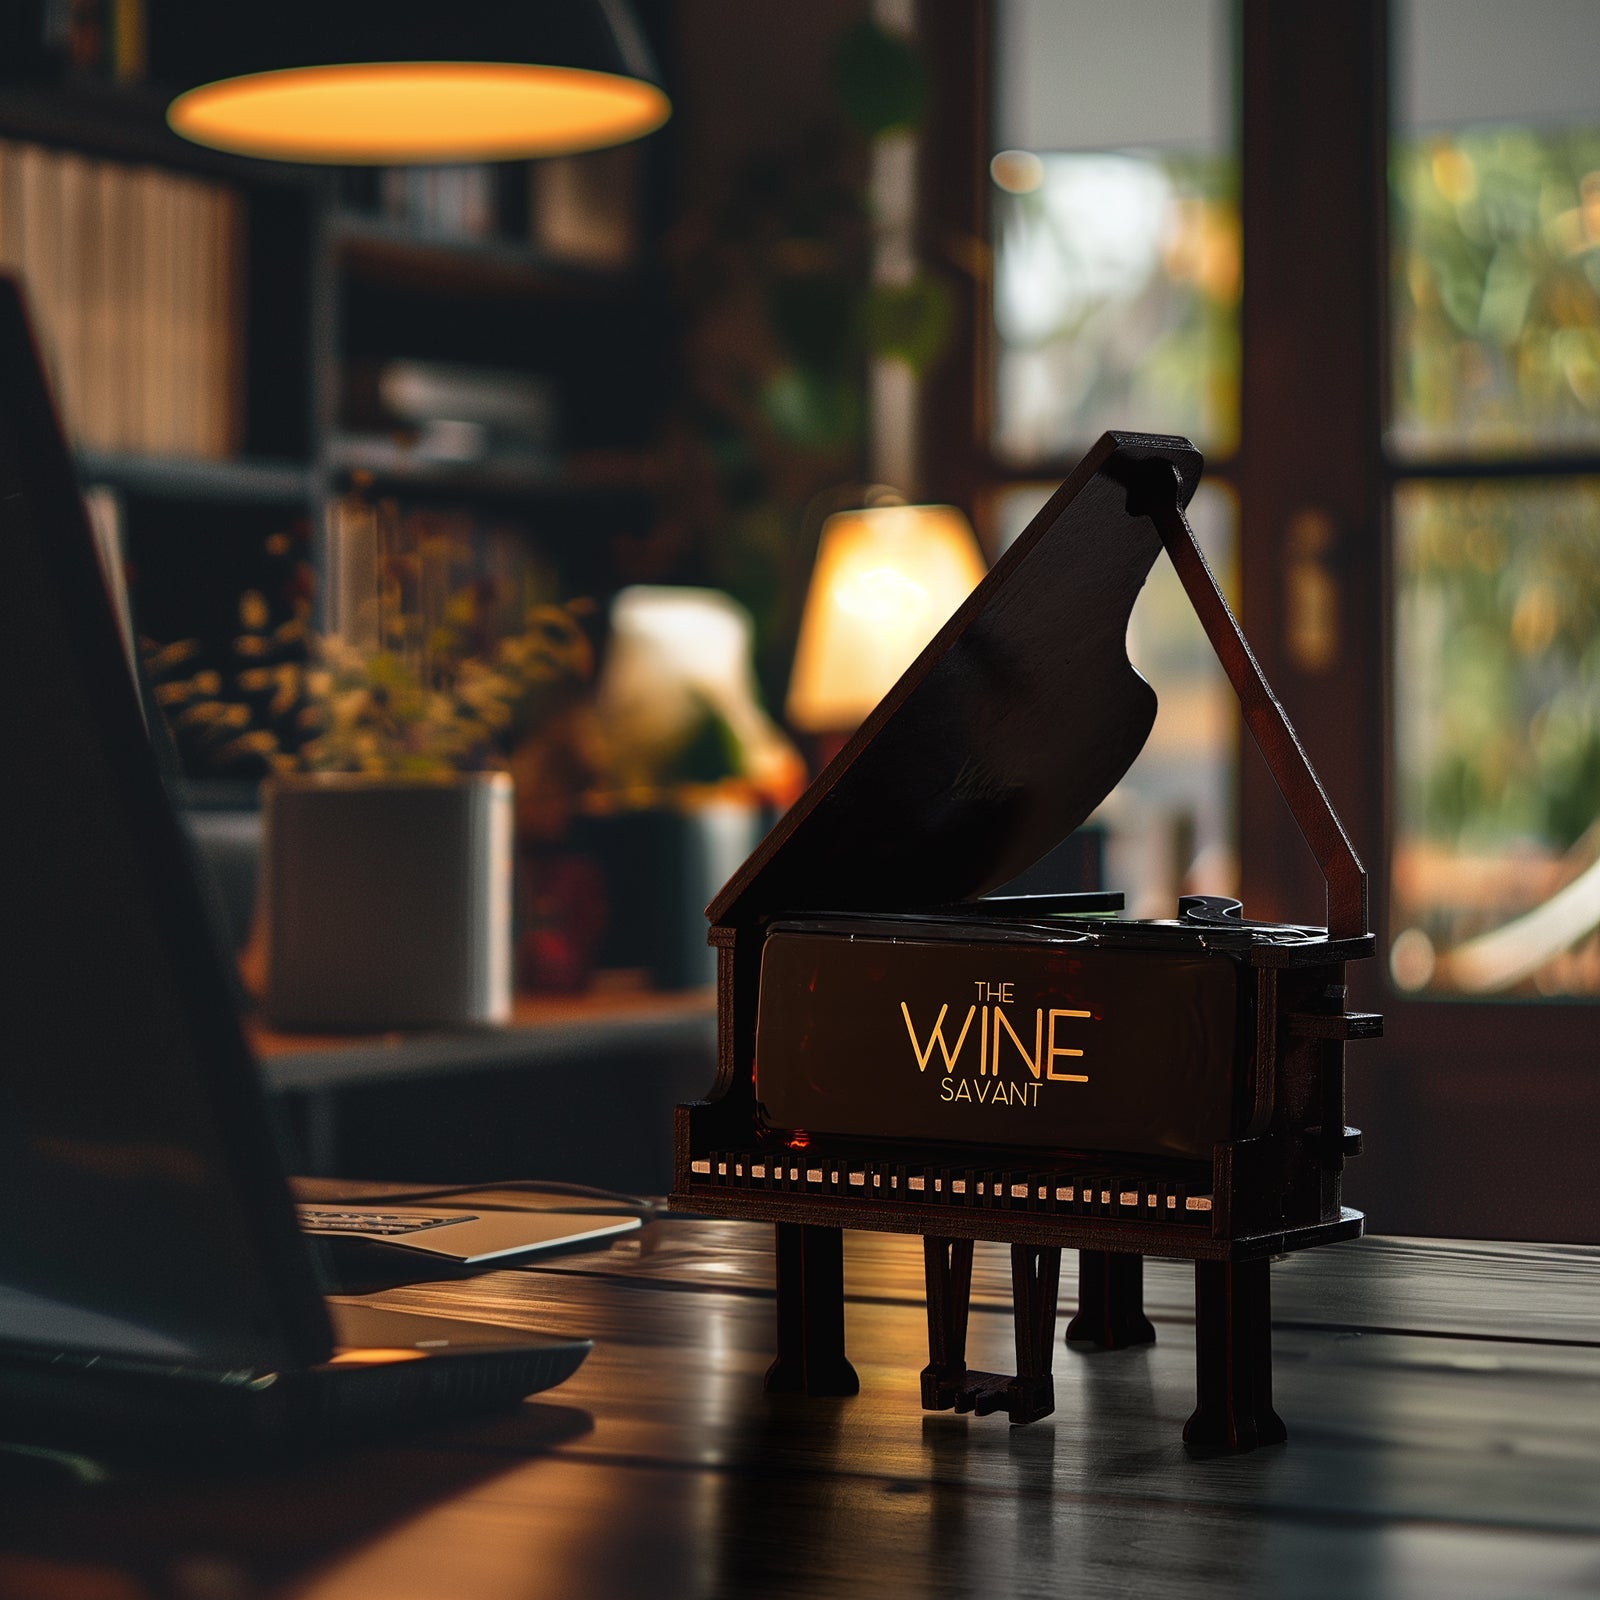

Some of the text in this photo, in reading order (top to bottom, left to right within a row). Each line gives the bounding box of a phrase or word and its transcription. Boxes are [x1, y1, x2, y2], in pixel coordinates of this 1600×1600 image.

[974, 981, 1015, 1004] THE
[900, 1001, 1091, 1083] WINE
[940, 1077, 1043, 1107] SAVANT
